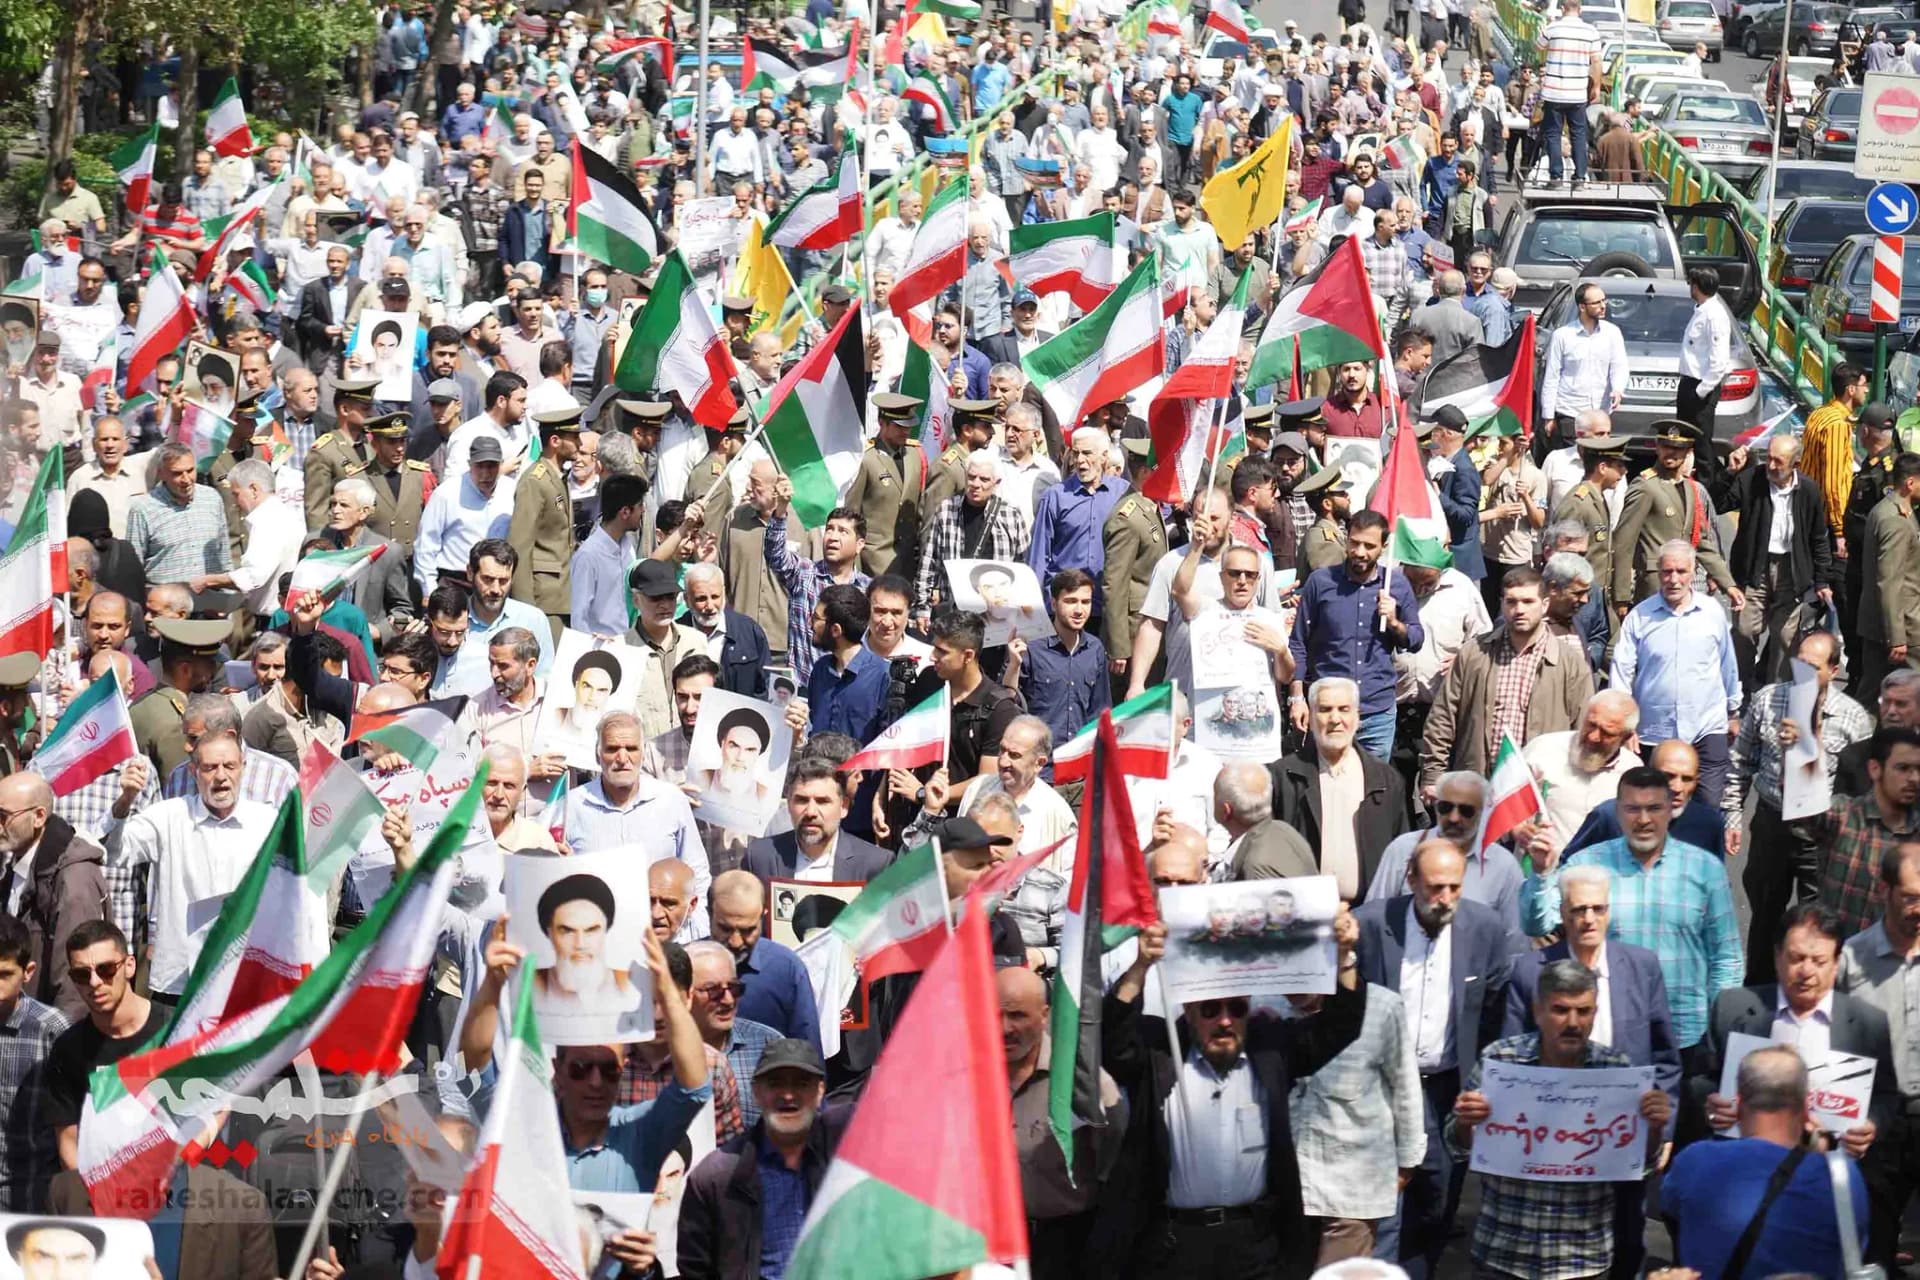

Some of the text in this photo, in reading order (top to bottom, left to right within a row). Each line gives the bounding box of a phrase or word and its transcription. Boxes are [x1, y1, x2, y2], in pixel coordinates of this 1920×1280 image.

[1864, 139, 1889, 148] اتوبوس
[419, 774, 470, 808] سپاه
[1485, 1112, 1638, 1161] سپاه مچکریم
